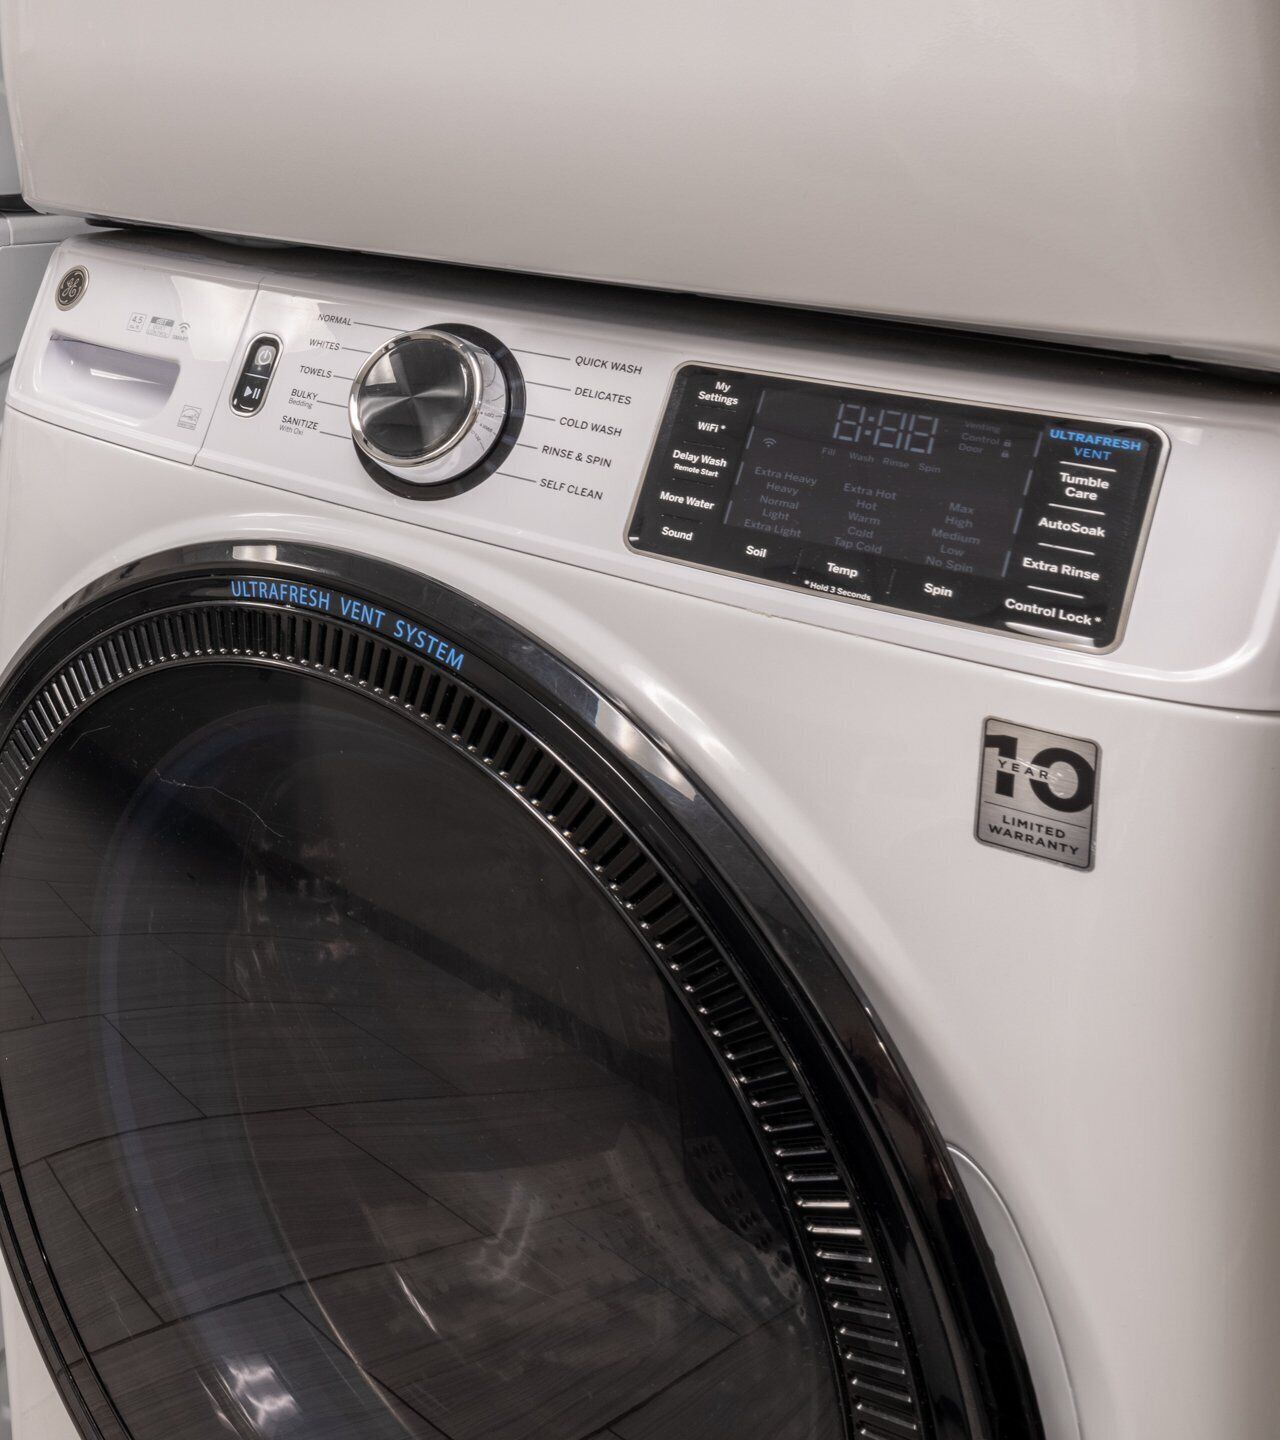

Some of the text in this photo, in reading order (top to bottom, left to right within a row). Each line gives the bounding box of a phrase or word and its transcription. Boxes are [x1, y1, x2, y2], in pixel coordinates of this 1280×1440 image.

[318, 314, 352, 326] NORMAL
[309, 338, 340, 351] WHITES
[300, 365, 333, 378] TOWELS
[575, 355, 643, 375] QUICK WASH
[291, 388, 318, 401] BULKY
[715, 381, 731, 393] My
[288, 397, 314, 410] Bedding
[574, 387, 632, 405] DELICATES
[698, 391, 739, 406] Settings
[281, 415, 319, 430] SANITIZE
[559, 417, 622, 437] COLD WASH
[697, 422, 720, 433] WiFi
[961, 432, 1000, 446] Control
[1049, 428, 1143, 452] ULTRAFRESH
[542, 445, 612, 468] RINSE & SPIN
[958, 442, 984, 455] Door
[1074, 446, 1112, 461] VENT
[673, 450, 728, 468] Delay Wash
[849, 451, 875, 463] Wash
[919, 462, 941, 475] Spin
[673, 463, 719, 478] Remote Start
[754, 466, 818, 487] Extra Heavy
[1059, 471, 1110, 490] Tumble
[540, 478, 603, 501] SELF CLEAN
[766, 481, 799, 497] Heavy
[844, 482, 898, 501] Extra Hot
[1065, 487, 1098, 501] Care
[660, 491, 715, 510] More Water
[760, 495, 800, 511] Normal
[856, 499, 878, 511] Hot
[949, 502, 975, 515] Max
[762, 508, 789, 523] Light
[848, 511, 880, 526] Warm
[945, 515, 973, 529] High
[661, 526, 693, 541] Sound
[744, 519, 802, 539] Extra Light
[847, 526, 874, 539] Cold
[1038, 517, 1106, 538] AutoSoak
[931, 528, 981, 545] Medium
[746, 545, 767, 558] Soil
[834, 536, 883, 555] Tap Cold
[940, 544, 965, 557] Low
[827, 561, 858, 579] Temp
[926, 555, 974, 575] No Spin
[1022, 557, 1100, 581] Extra Rinse
[831, 585, 836, 594] 3
[837, 587, 872, 602] Seconds
[924, 582, 953, 598] Spin
[1005, 598, 1092, 626] Control Lock
[230, 580, 464, 671] ULTRAFRESH VENT SYSTEM
[984, 735, 1096, 813] 10
[998, 759, 1048, 780] YEAR
[1002, 815, 1066, 839] LIMITED
[988, 824, 1080, 855] WARRANTY
